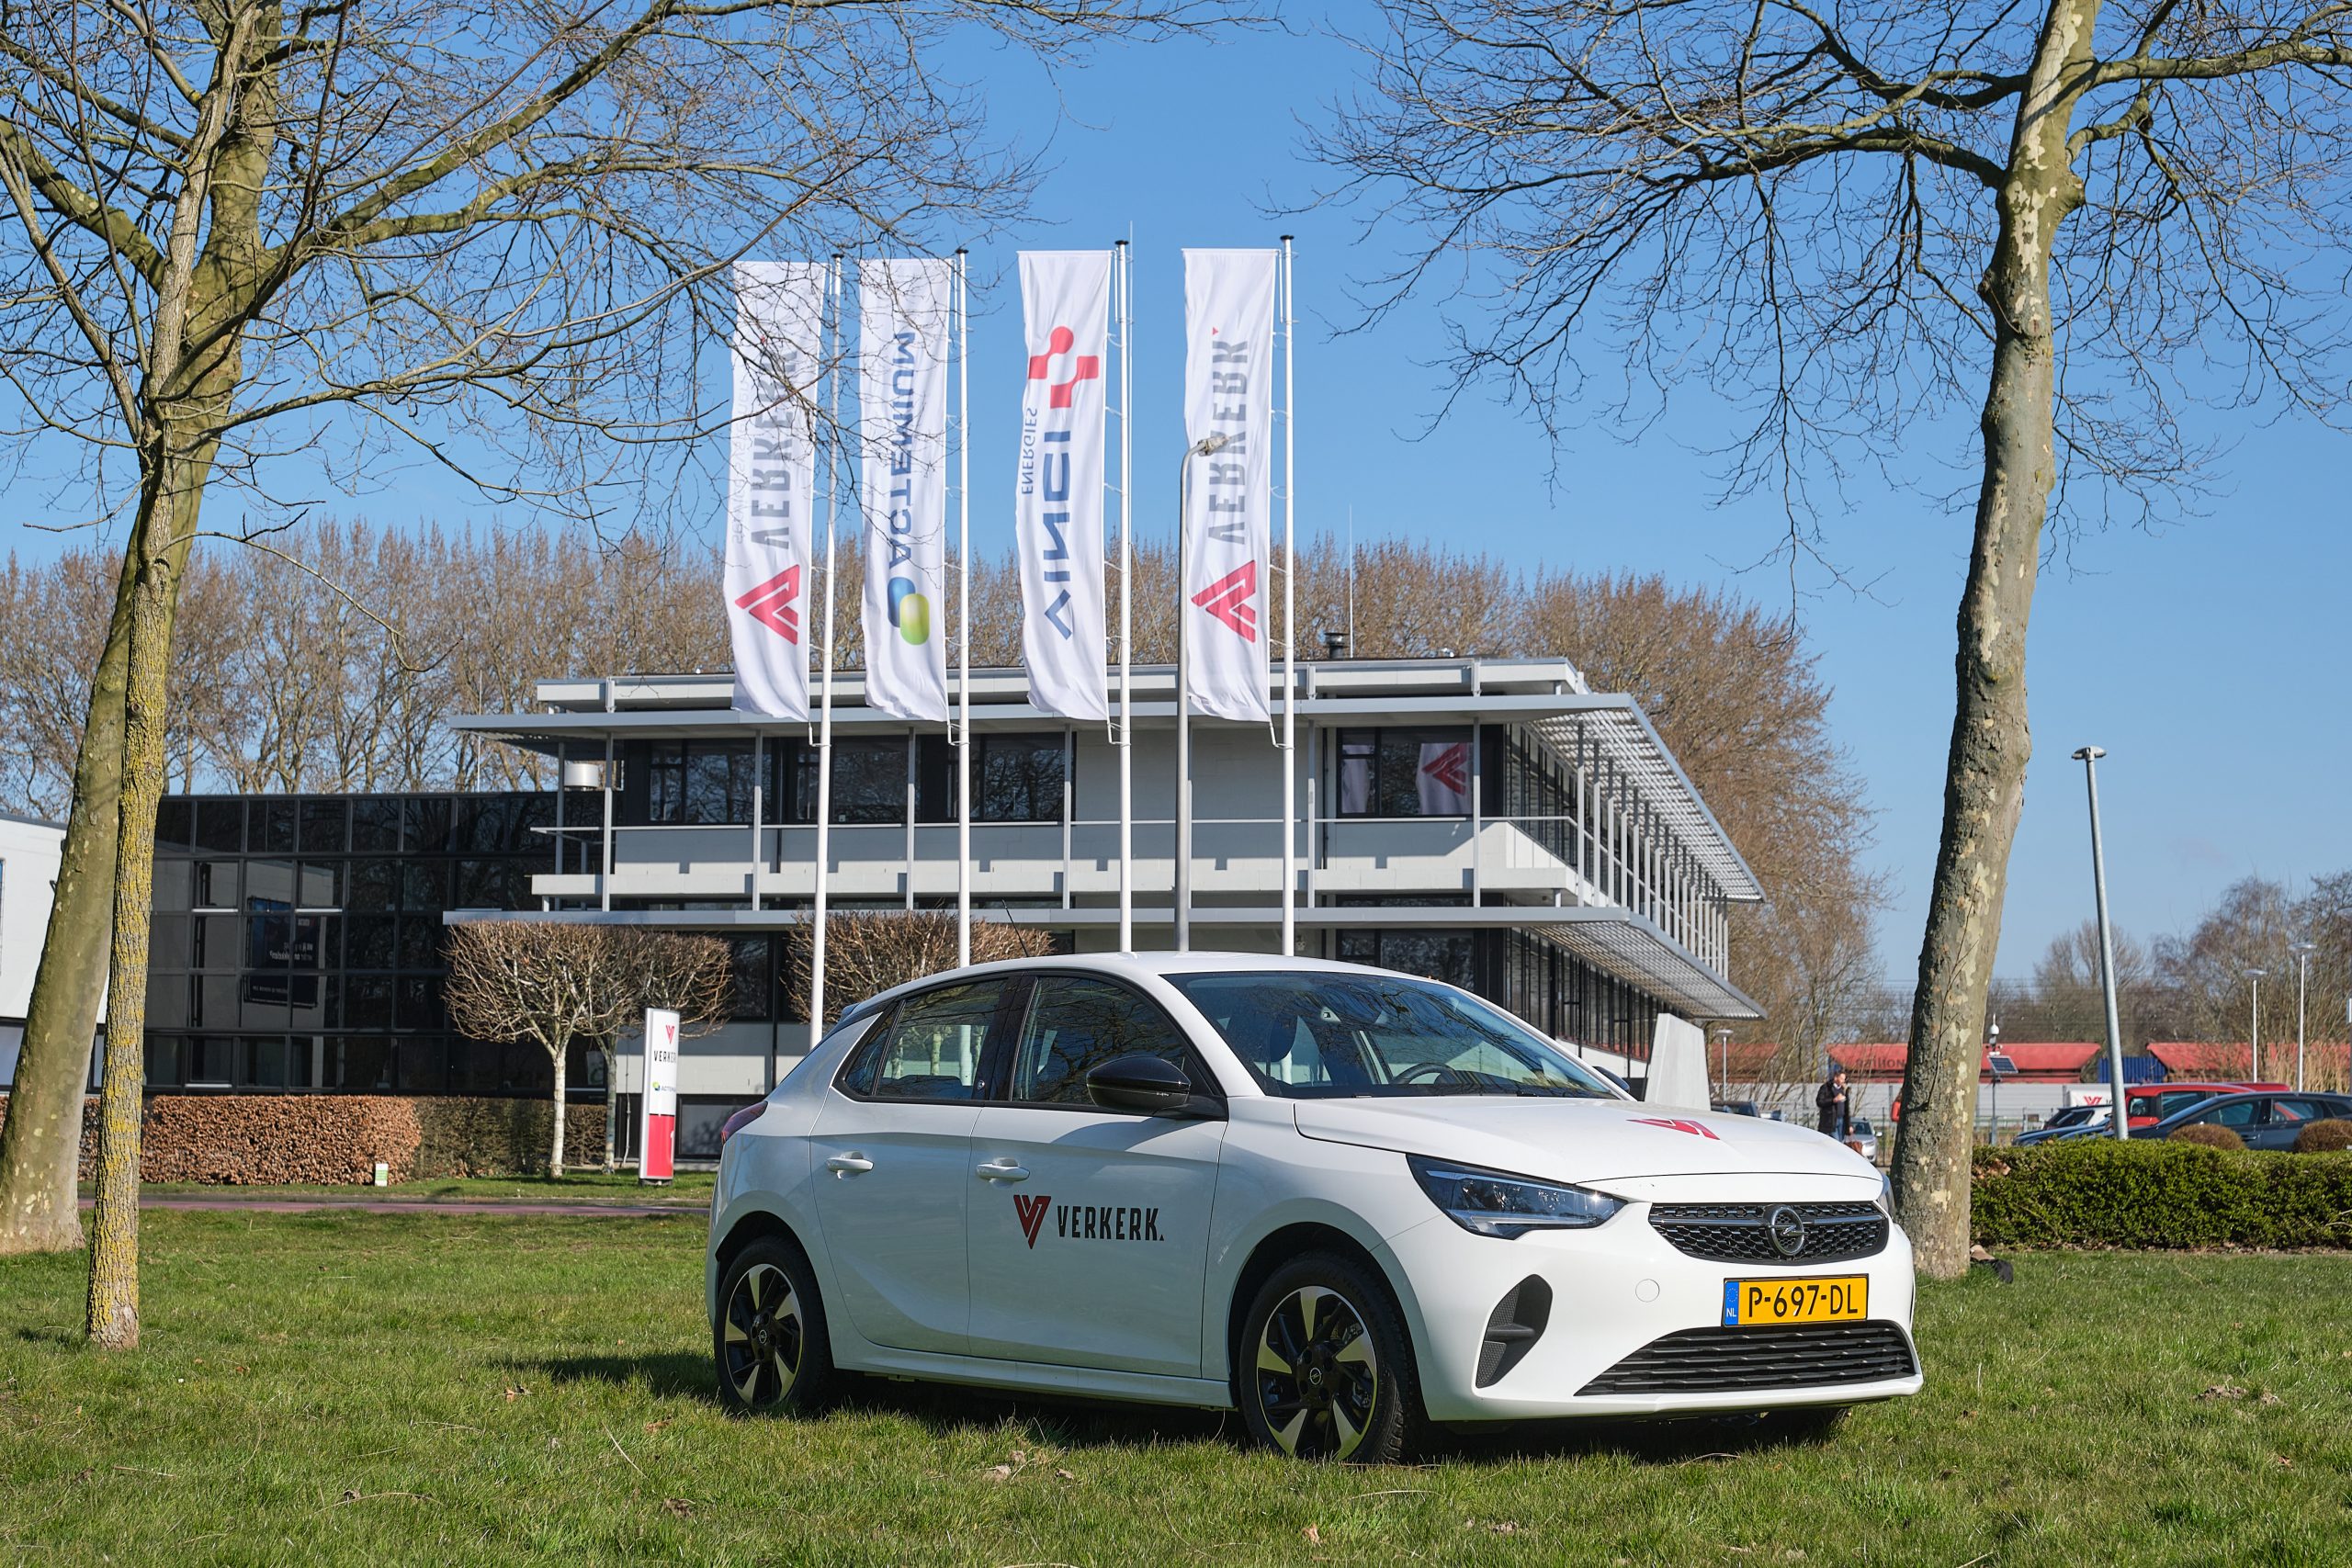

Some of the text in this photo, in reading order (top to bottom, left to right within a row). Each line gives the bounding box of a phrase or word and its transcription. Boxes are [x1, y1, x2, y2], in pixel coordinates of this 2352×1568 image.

[653, 1050, 676, 1063] VERKER
[1748, 1284, 1858, 1317] P-697-DL
[1726, 1307, 1736, 1317] NL
